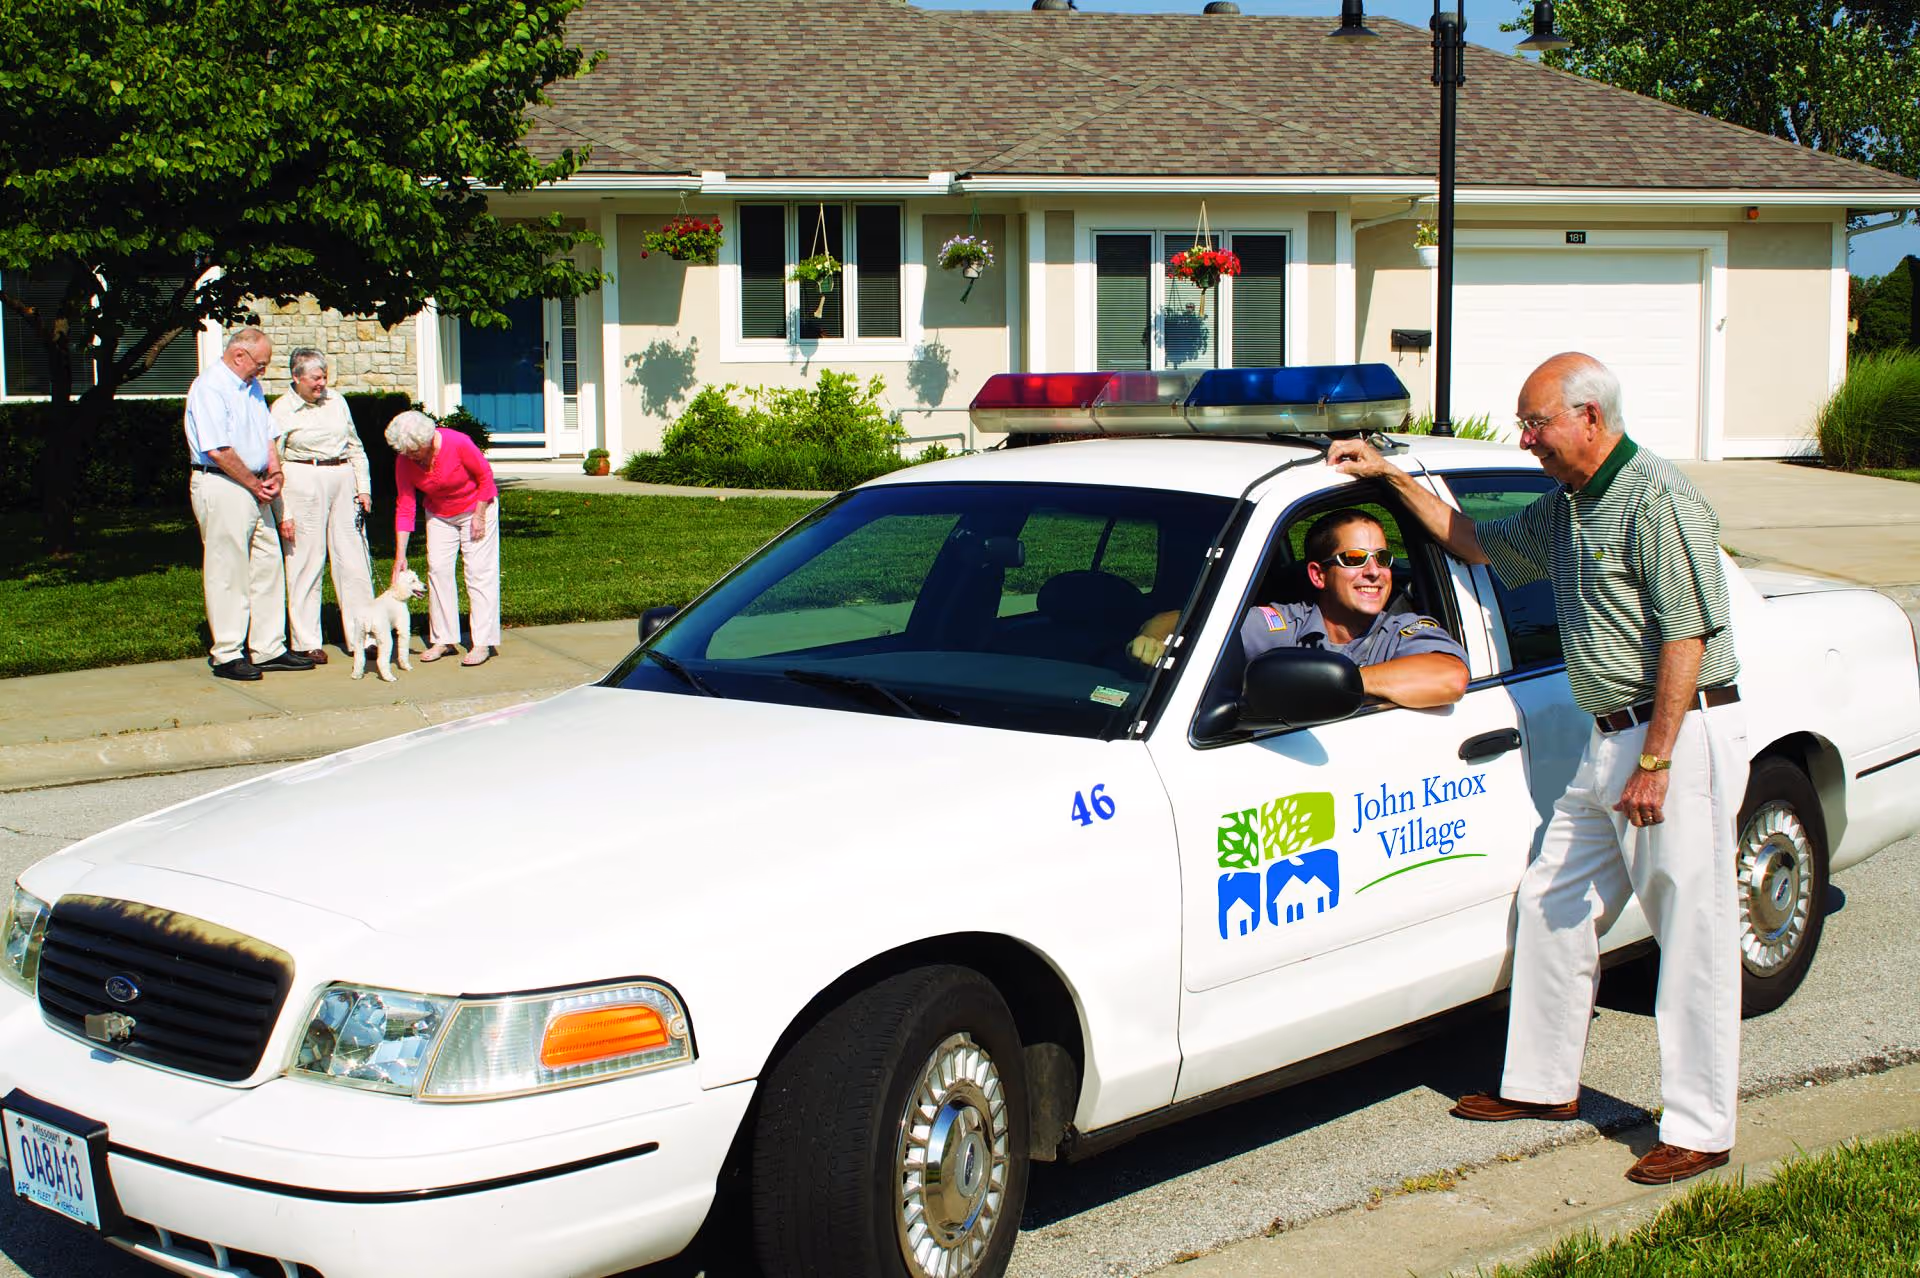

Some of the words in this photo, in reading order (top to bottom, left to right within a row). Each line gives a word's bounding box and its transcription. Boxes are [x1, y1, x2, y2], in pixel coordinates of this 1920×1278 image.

[1569, 233, 1583, 242] 181
[1071, 783, 1116, 827] 46
[1352, 783, 1415, 834] John
[1422, 773, 1487, 808] Knox
[1377, 816, 1466, 859] Village
